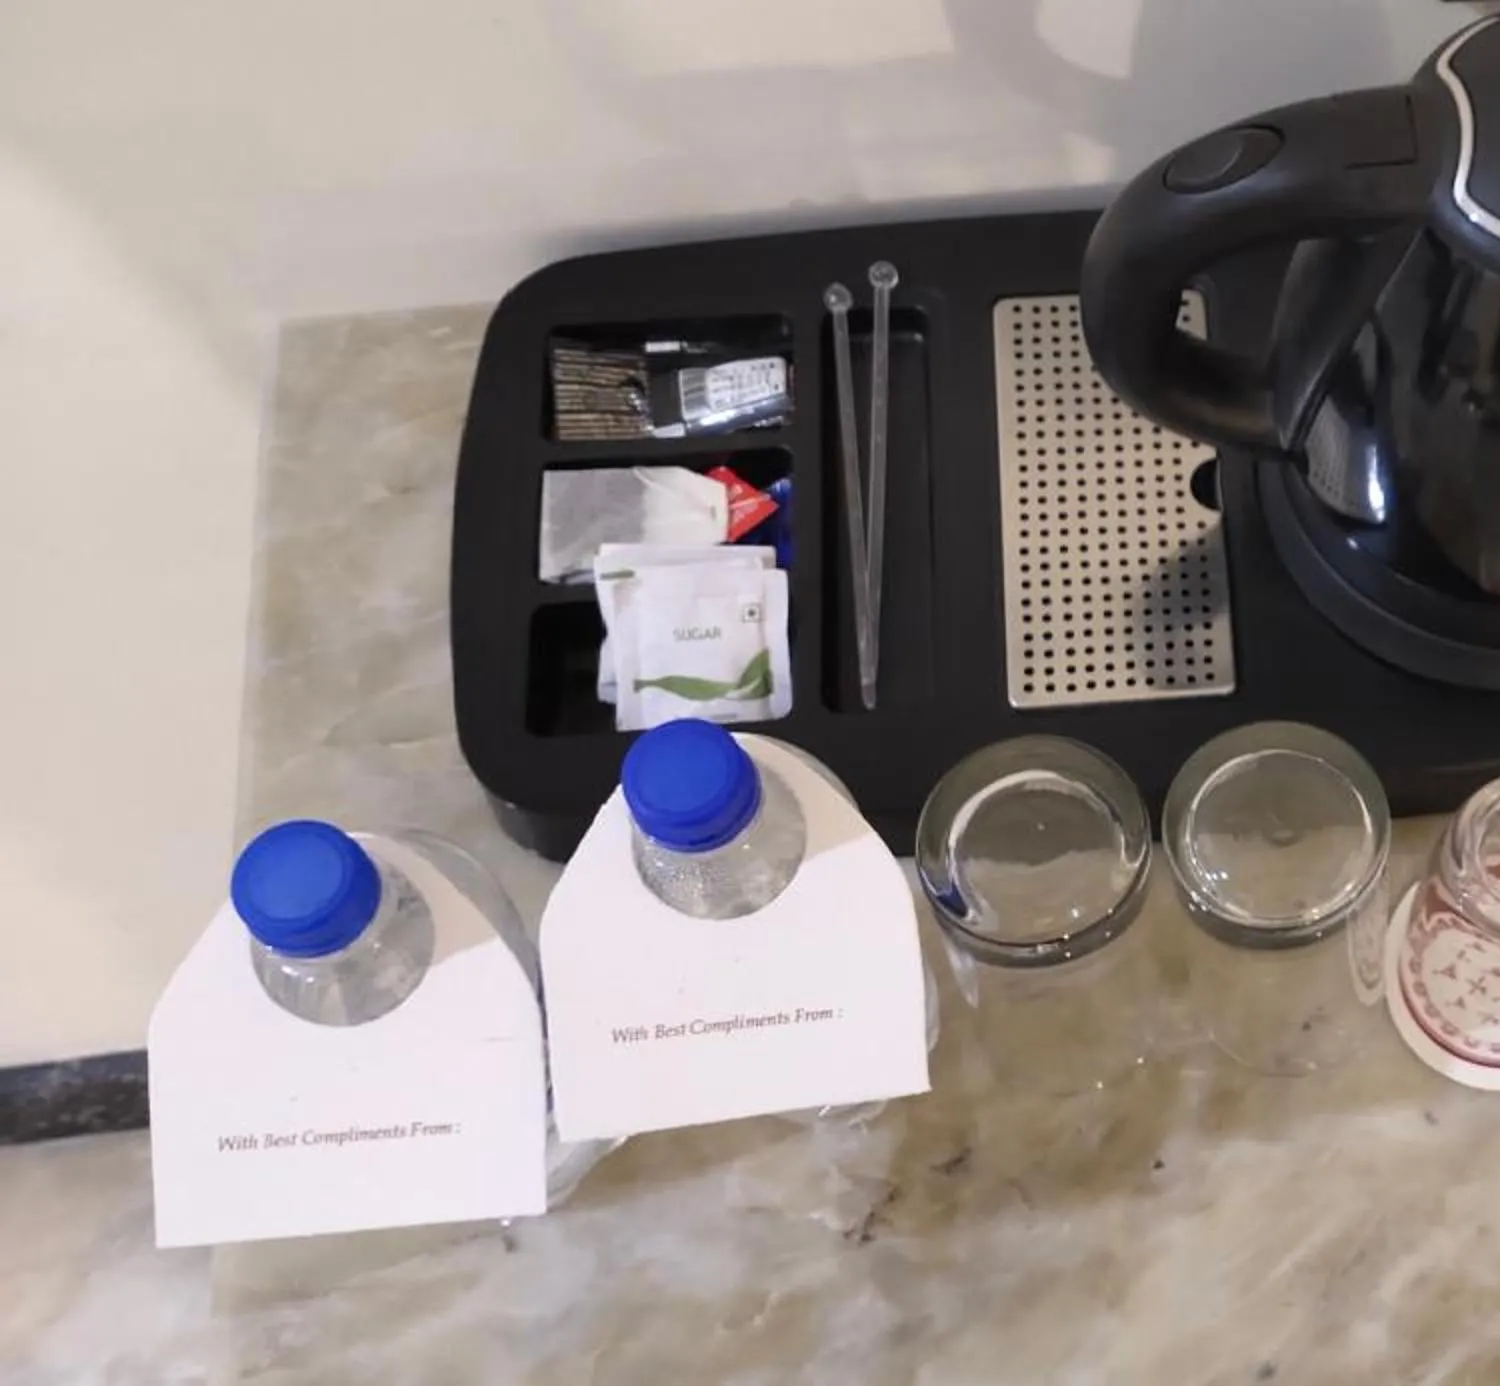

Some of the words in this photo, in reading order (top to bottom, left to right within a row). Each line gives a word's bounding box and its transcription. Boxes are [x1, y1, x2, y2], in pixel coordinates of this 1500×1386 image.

[672, 626, 722, 642] SUGAR
[611, 1025, 650, 1044] With
[654, 1022, 686, 1040] Best
[689, 1012, 790, 1037] Compliments
[216, 1134, 258, 1152] With
[263, 1132, 297, 1149] Best
[302, 1124, 406, 1147] Compliments
